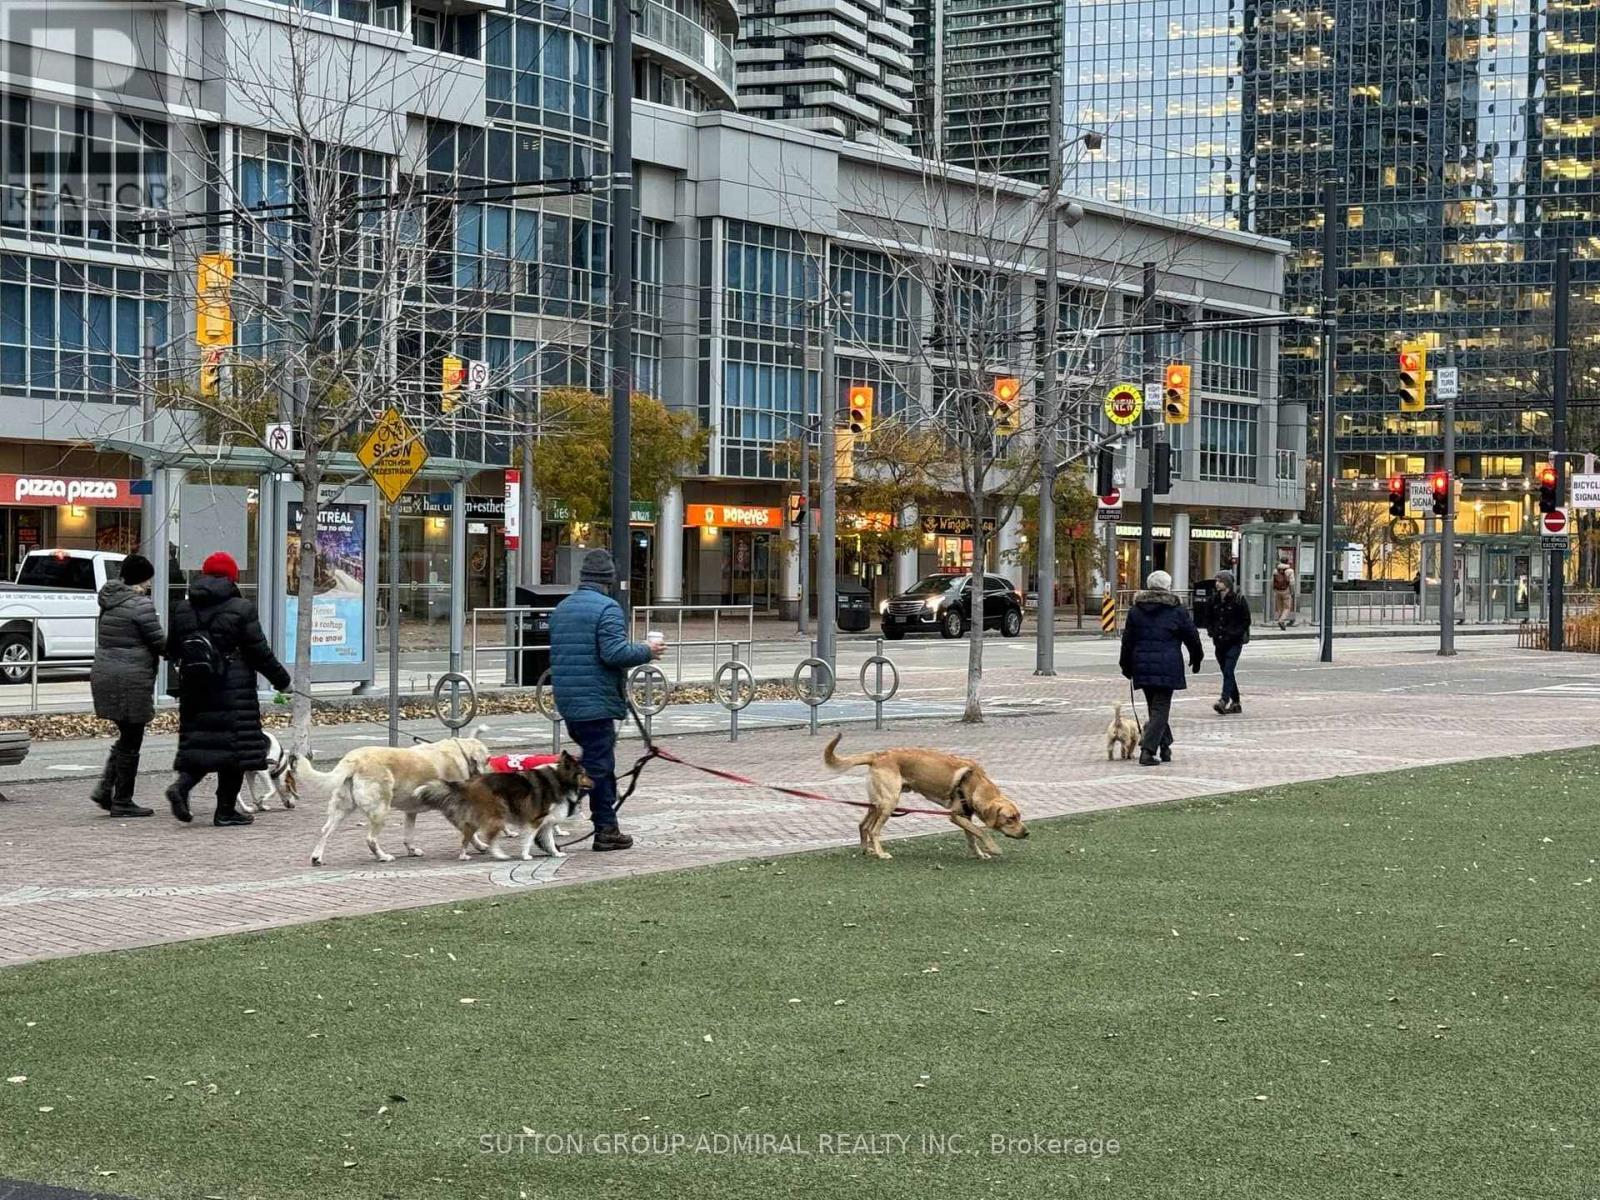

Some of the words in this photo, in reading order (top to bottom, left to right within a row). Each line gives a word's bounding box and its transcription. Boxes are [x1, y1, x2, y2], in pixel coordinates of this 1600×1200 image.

[15, 479, 65, 501] pizza
[68, 481, 117, 503] pizza
[1411, 497, 1433, 507] SIGNA
[1191, 528, 1225, 539] STARBUCKS
